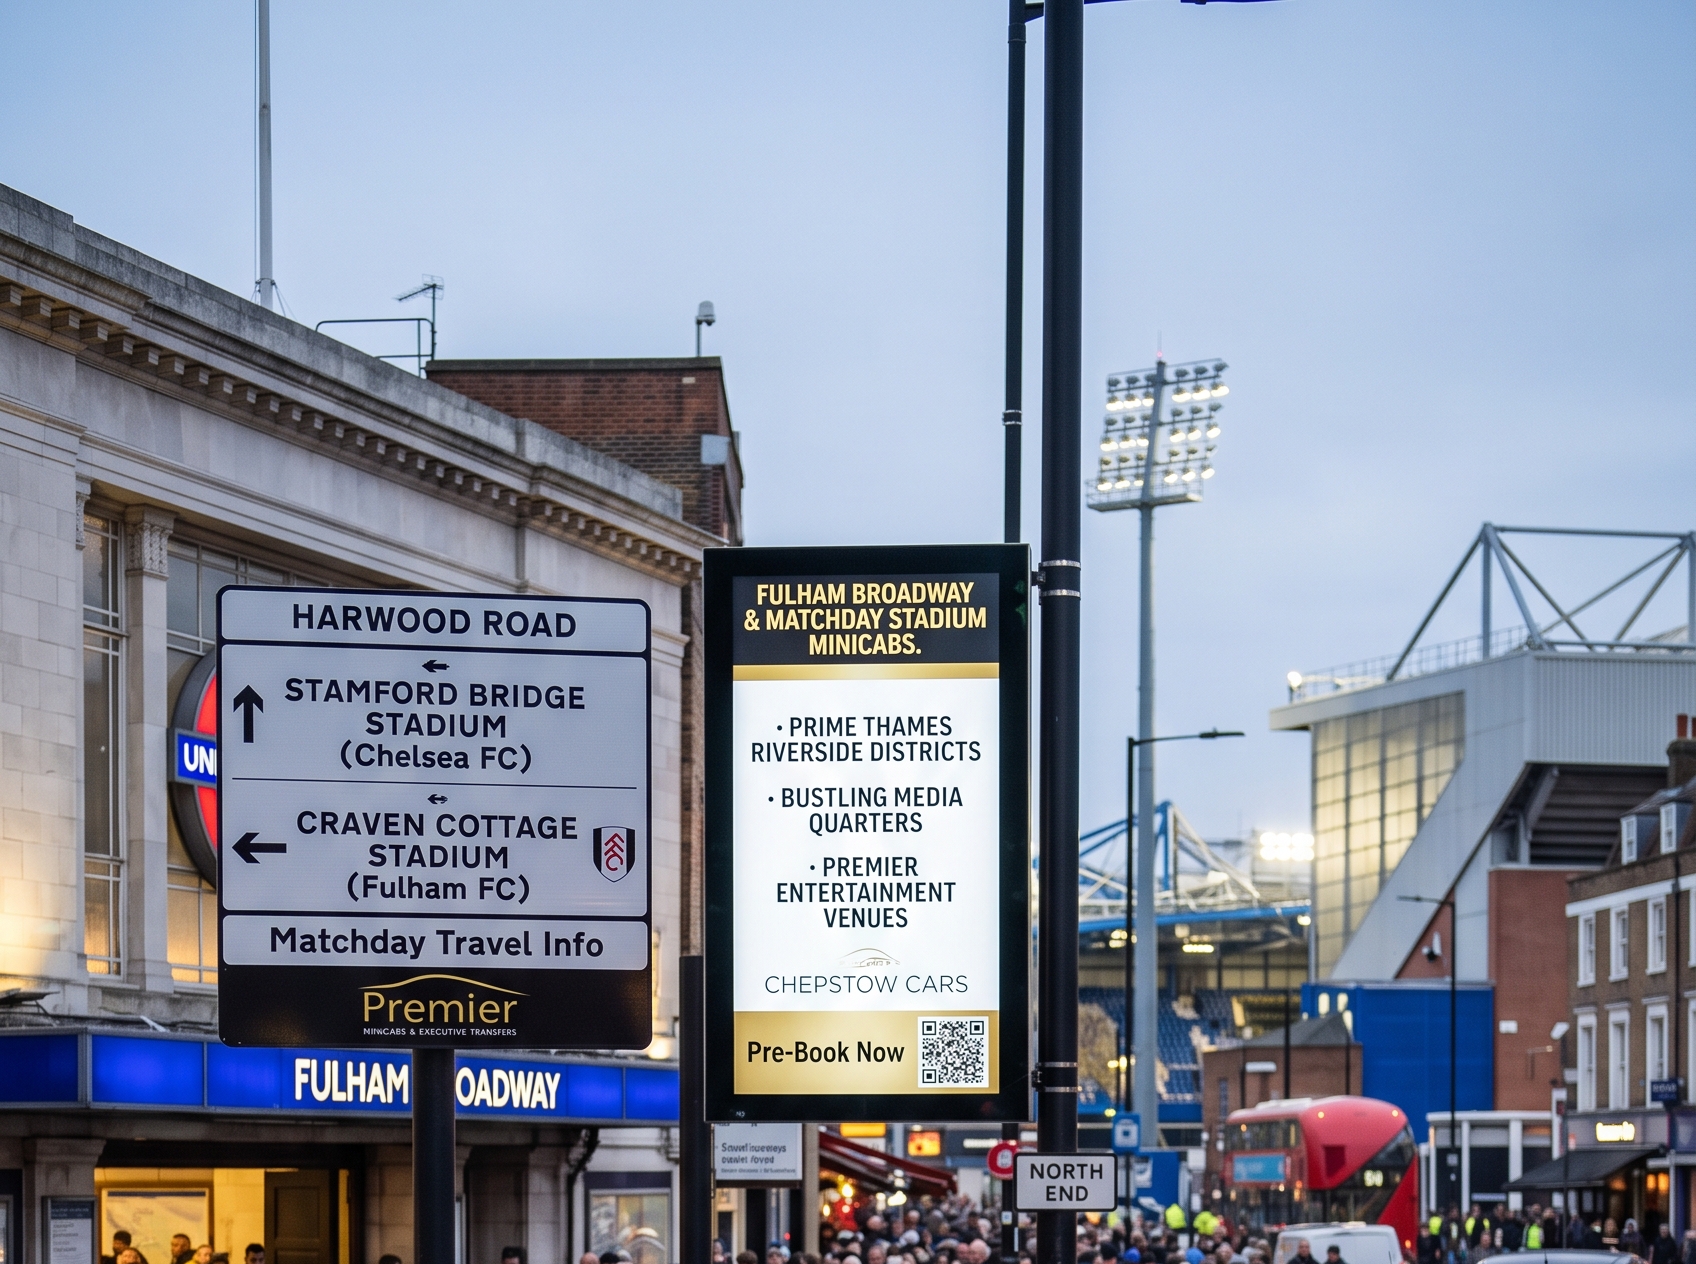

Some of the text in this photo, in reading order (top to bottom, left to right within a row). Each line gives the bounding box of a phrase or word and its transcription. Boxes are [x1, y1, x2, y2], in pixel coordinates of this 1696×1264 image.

[757, 581, 975, 606] FULHAM BROADWAY
[293, 603, 577, 638] HARWOOD ROAD
[743, 606, 987, 631] & MATCHDAY STADIUM
[809, 632, 922, 656] MINICABS.
[284, 677, 585, 710] STAMFORD BRIDGE
[365, 711, 506, 739] STADIUM
[790, 715, 952, 737] PRIME THAMES
[183, 742, 218, 777] UN
[340, 739, 532, 775] (Chelsea FC)
[751, 740, 981, 763] RIVERSIDE DISTRICTS
[781, 786, 963, 808] BUSTLING MEDIA
[296, 810, 578, 840] CRAVEN COTTAGE
[809, 812, 923, 834] QUARTERS
[368, 843, 508, 870] STADIUM
[823, 856, 919, 877] PREMIER
[347, 871, 530, 905] (Fulham FC)
[777, 881, 957, 903] ENTERTAINMENT
[823, 907, 908, 928] VENUES
[270, 926, 604, 960] Matchday Travel Info
[764, 974, 968, 994] CHEPSTOW CARS
[363, 990, 519, 1024] Premier
[409, 1028, 416, 1036] &
[419, 1028, 467, 1036] EXECUTIVE
[469, 1028, 517, 1036] TRANSFERS
[747, 1041, 905, 1063] Pre-Book Now
[294, 1058, 561, 1110] FULHAM OADWAY
[1030, 1163, 1103, 1180] NORTH
[1045, 1185, 1089, 1202] END
